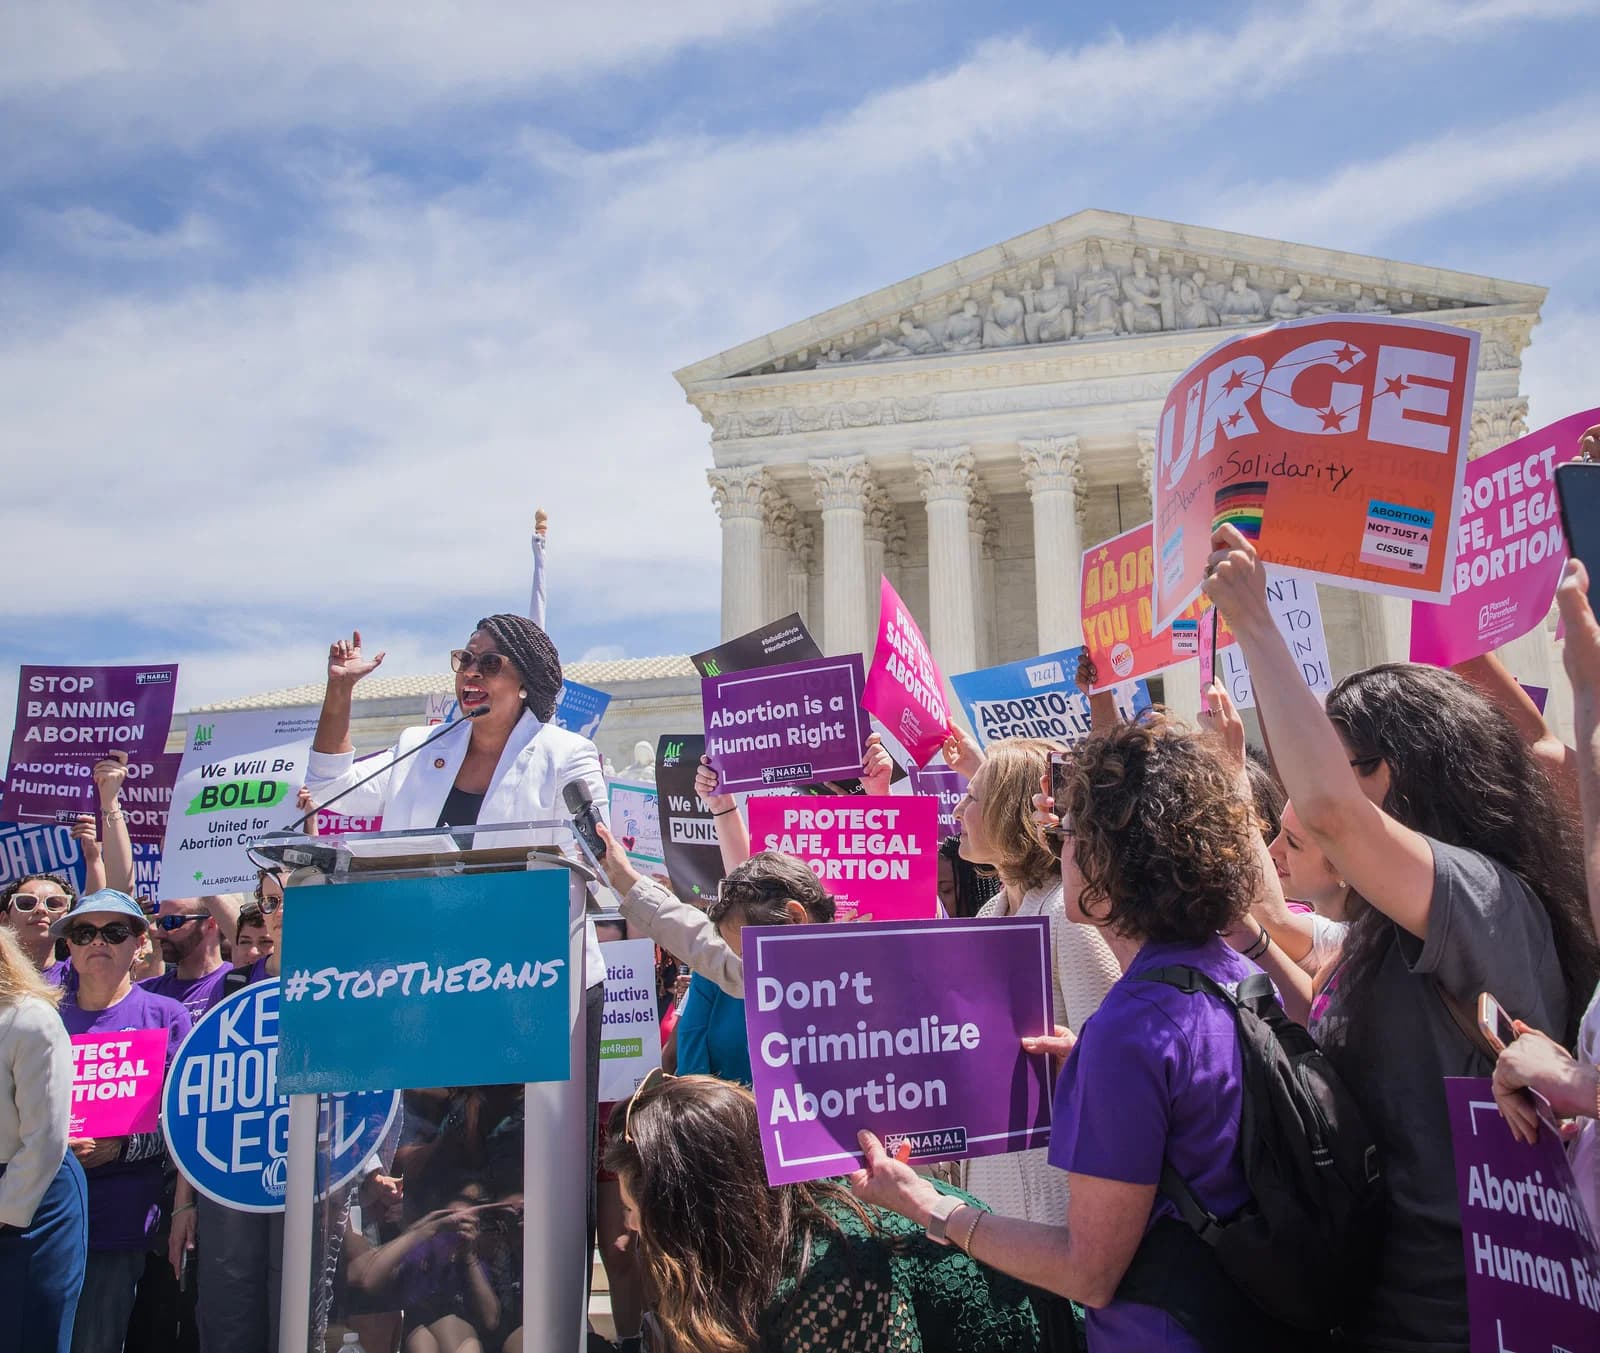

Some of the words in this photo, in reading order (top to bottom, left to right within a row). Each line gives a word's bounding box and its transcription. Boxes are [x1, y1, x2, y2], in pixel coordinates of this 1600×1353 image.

[1161, 339, 1457, 491] URGE
[1222, 450, 1354, 492] Solidarity
[1459, 445, 1557, 518] ROTECT
[1371, 506, 1431, 525] ABORTION:
[1455, 517, 1493, 557] FE,
[1500, 485, 1560, 536] LEGA
[1367, 521, 1391, 534] NOT
[1392, 527, 1419, 540] JUST
[1420, 533, 1429, 542] A
[1376, 542, 1414, 557] CISSUE
[1450, 524, 1563, 597] BORTION
[1084, 545, 1153, 609] ABOR
[1083, 605, 1130, 653] YOU
[886, 621, 918, 675] SAFE,
[29, 675, 94, 693] STOP
[1031, 663, 1057, 684] naf
[885, 652, 947, 730] ABORTION
[27, 700, 136, 718] BANNING
[709, 699, 799, 730] Abortion
[803, 694, 823, 714] is
[829, 695, 844, 712] a
[980, 692, 1074, 728] ABORTO:
[24, 724, 145, 743] ABORTION
[709, 730, 782, 756] Human
[786, 721, 846, 749] Right
[200, 764, 227, 779] We
[233, 760, 267, 776] Will
[272, 758, 294, 773] Be
[776, 765, 809, 777] NARAL
[11, 778, 81, 798] Human
[200, 780, 277, 810] BOLD
[667, 795, 692, 812] We
[208, 819, 249, 834] United
[251, 817, 270, 830] for
[783, 808, 900, 830] PROTECT
[179, 834, 233, 850] Abortion
[764, 833, 830, 858] SAFE,
[838, 833, 922, 855] LEGAL
[807, 859, 910, 881] ORTION
[606, 965, 634, 981] ticia
[603, 986, 649, 1003] ductiva
[756, 971, 874, 1012] Don't
[218, 988, 281, 1049] KE
[601, 1007, 655, 1025] odas/os!
[72, 1041, 132, 1061] TECT
[760, 1014, 981, 1068] Criminalize
[73, 1059, 149, 1081] LEGAL
[769, 1072, 948, 1125] Abortion
[910, 1131, 962, 1149] NARAL
[1467, 1163, 1576, 1231] Abortion
[1472, 1232, 1571, 1301] Human
